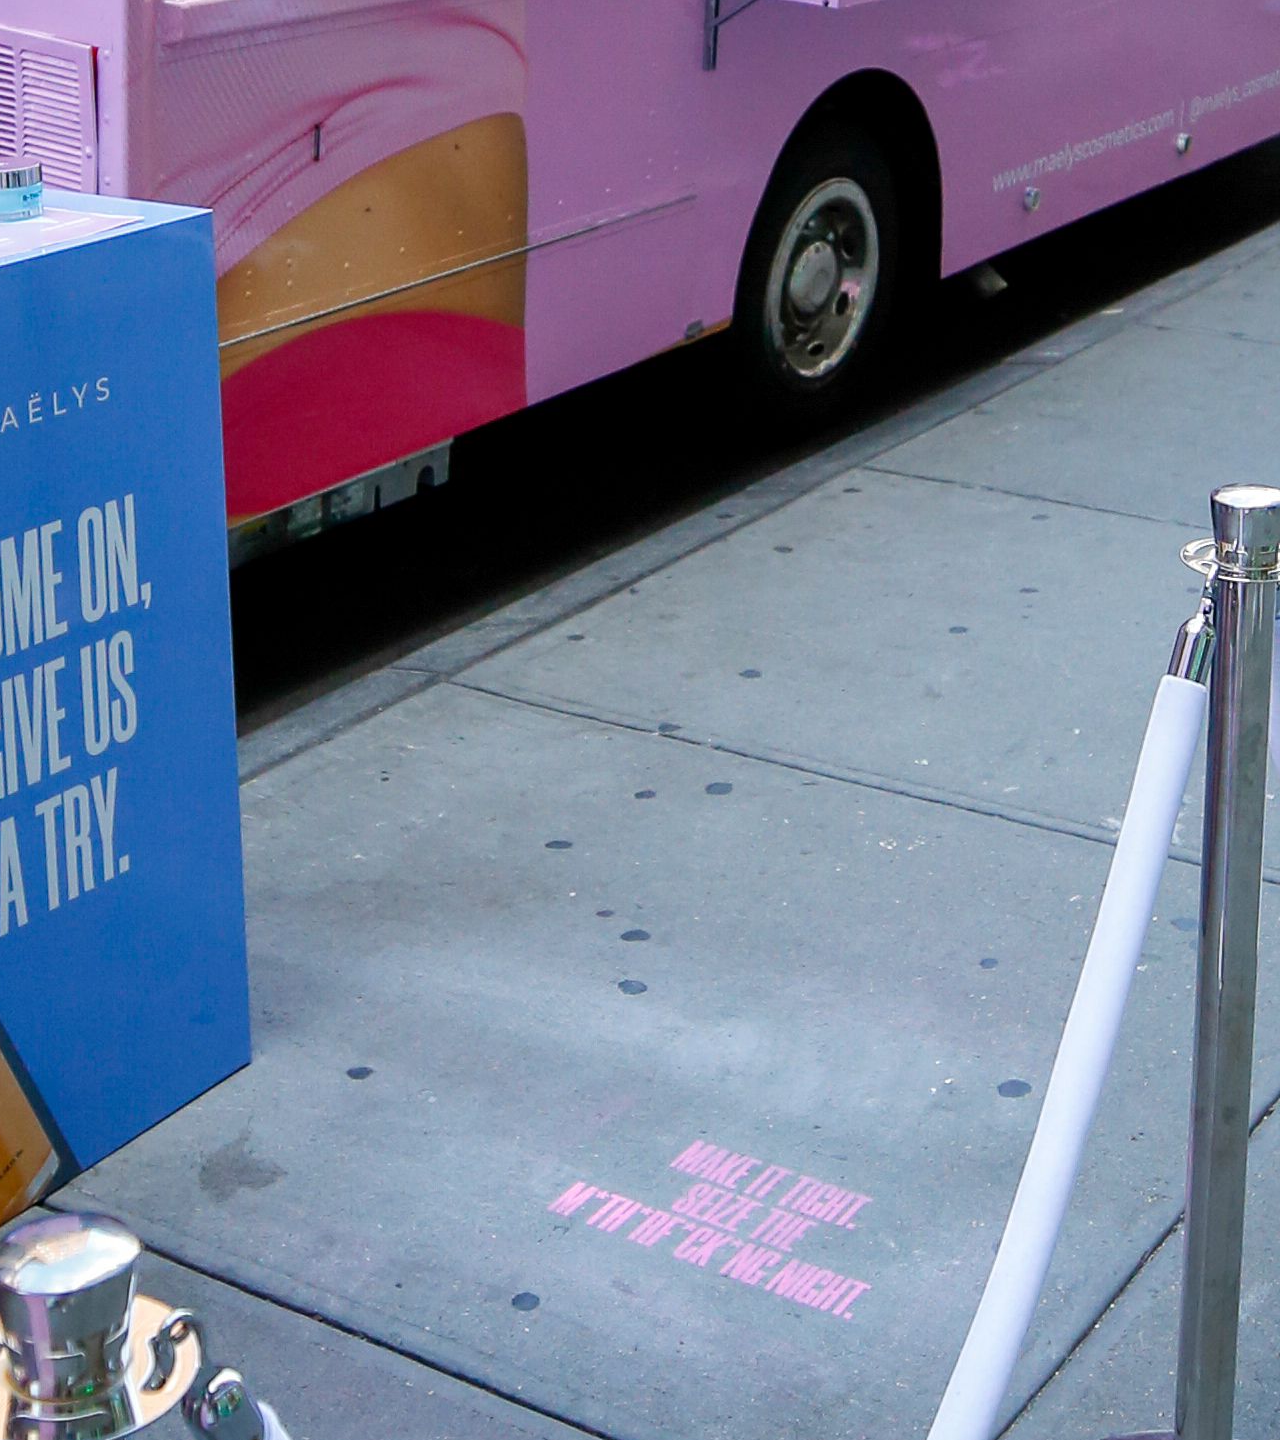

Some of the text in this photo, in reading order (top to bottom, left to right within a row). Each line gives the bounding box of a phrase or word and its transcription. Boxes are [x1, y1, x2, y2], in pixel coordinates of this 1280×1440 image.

[76, 492, 152, 623] ON,
[80, 629, 137, 757] US
[34, 766, 131, 911] TRY.
[669, 1139, 874, 1230] MAKE IT TIGHT.
[671, 1182, 818, 1252] SEIZE THE
[763, 1258, 873, 1321] NIGHT.
